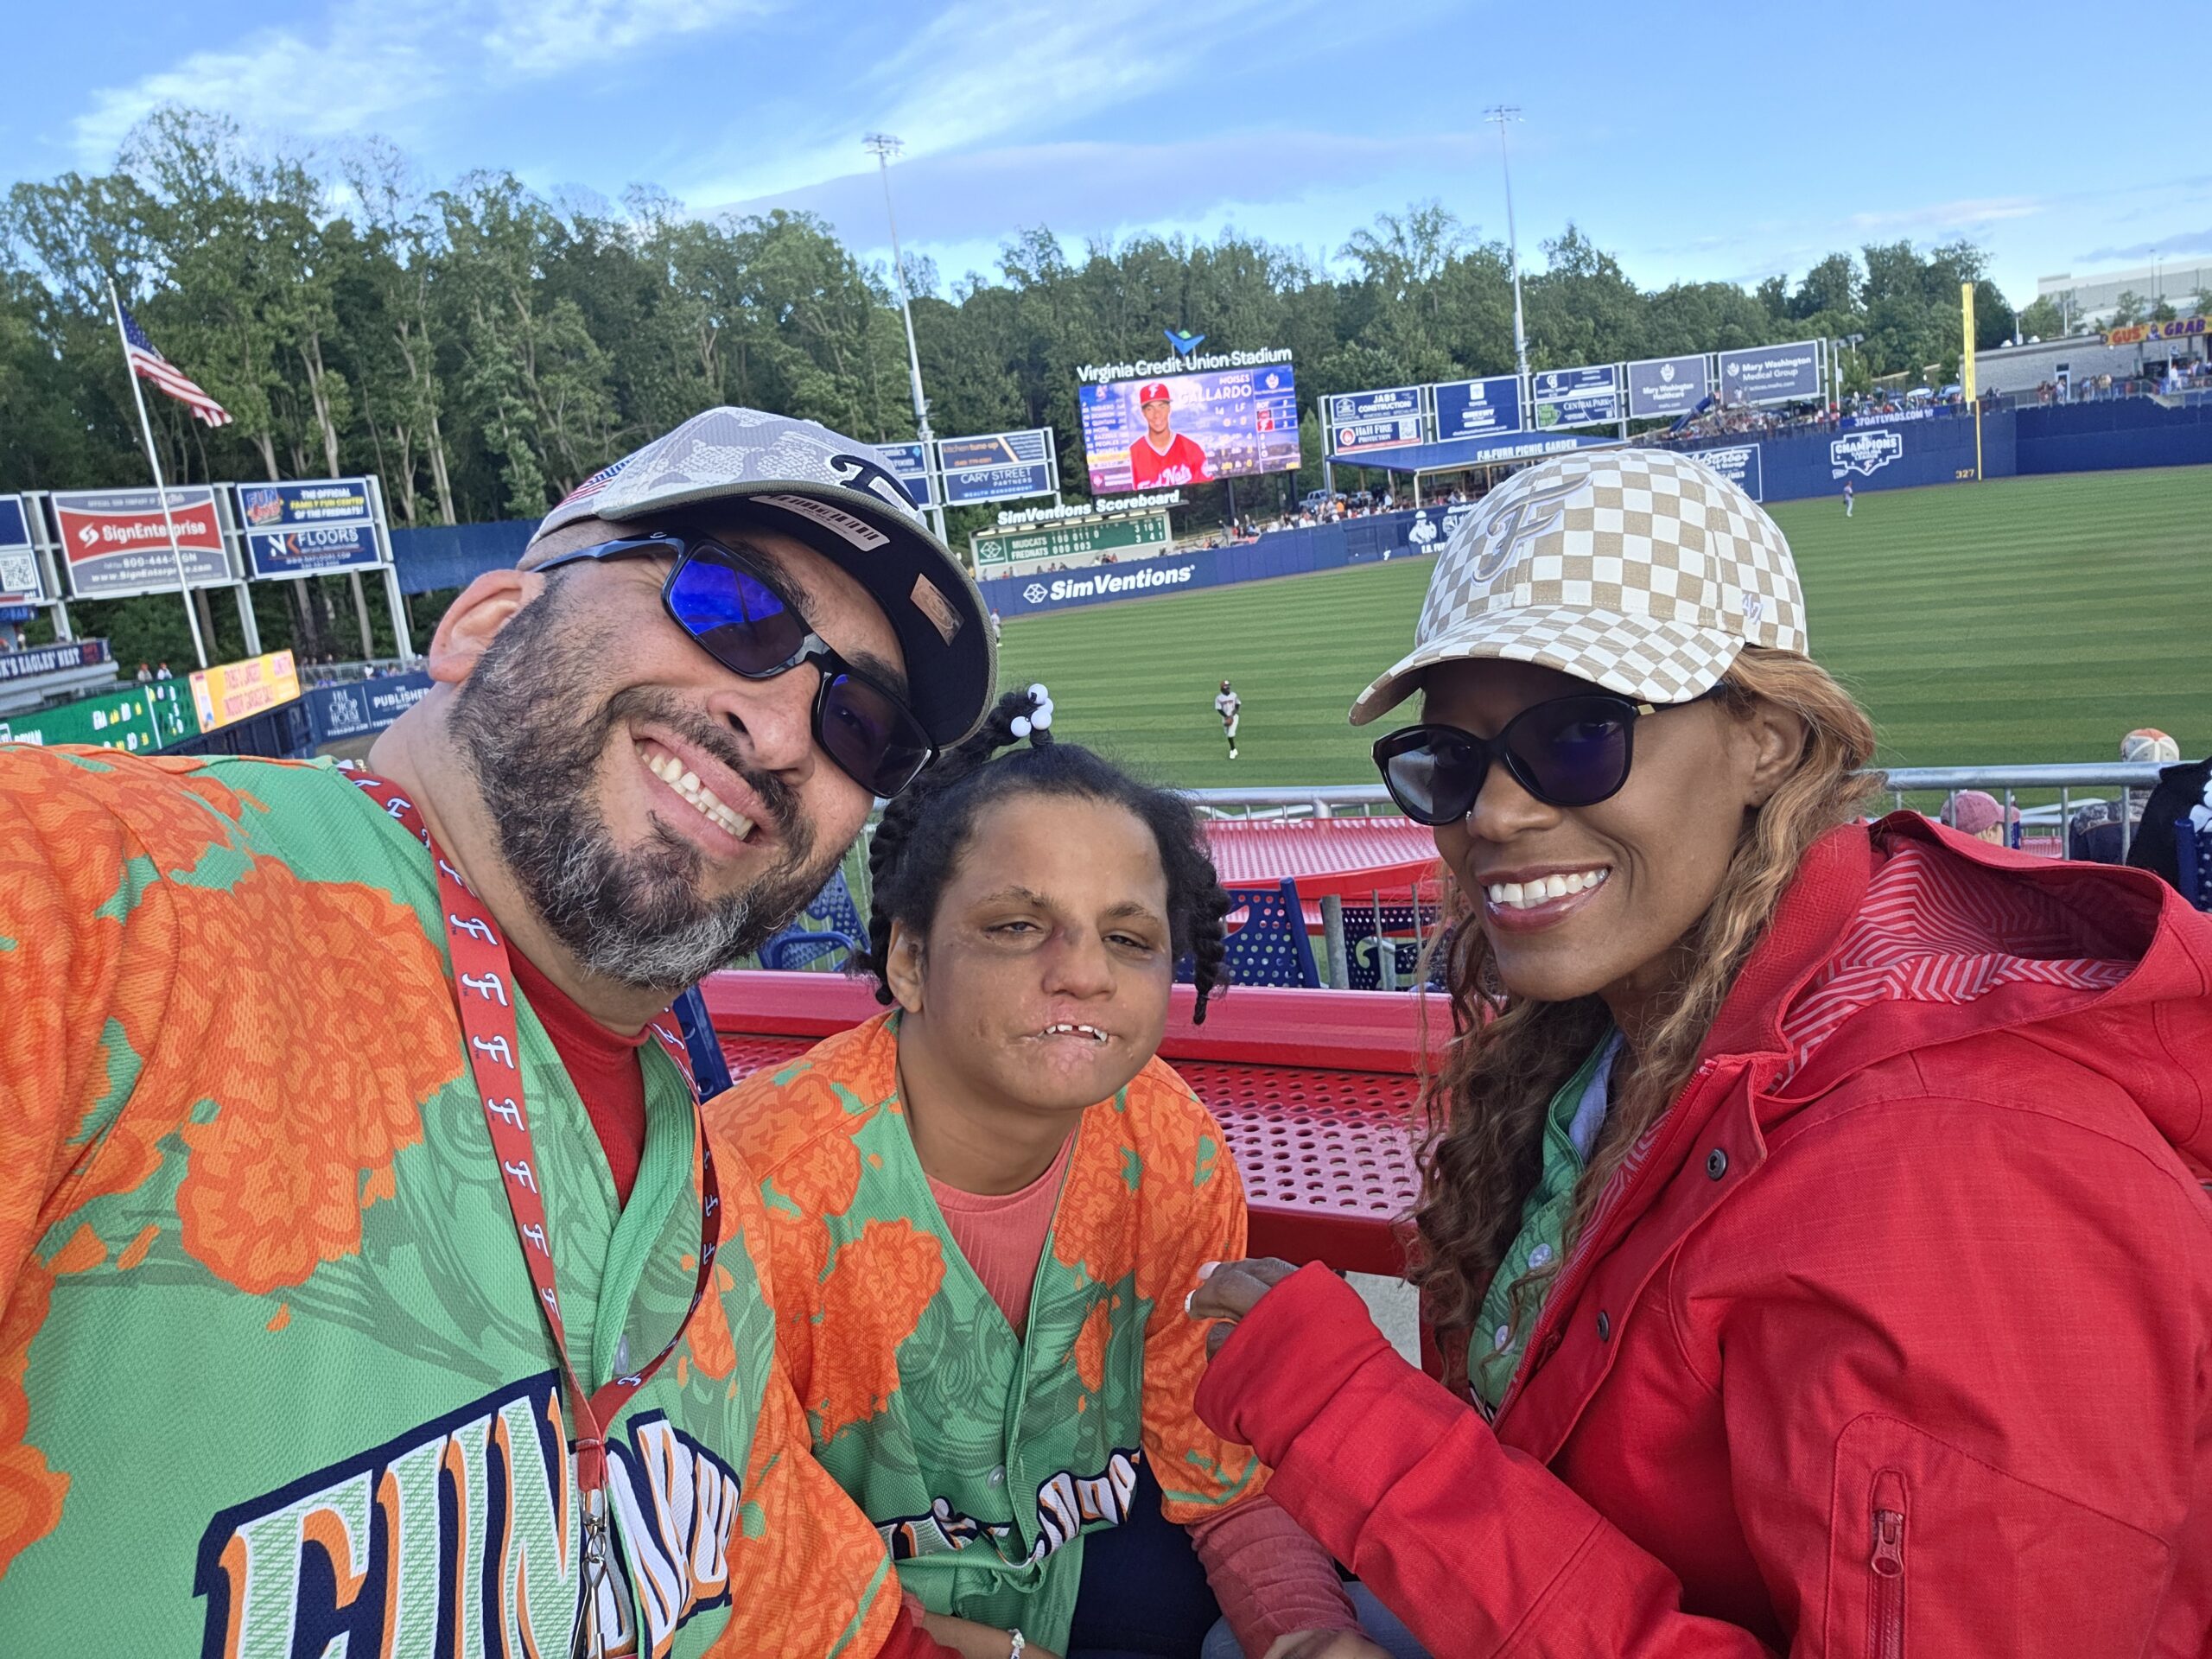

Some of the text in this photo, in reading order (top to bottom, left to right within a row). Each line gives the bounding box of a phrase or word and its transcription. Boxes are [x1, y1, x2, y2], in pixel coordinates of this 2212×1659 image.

[2164, 319, 2207, 336] GRAB
[1077, 346, 1293, 383] Virginia Credit Union Stadium
[1742, 356, 1811, 373] Mary Washington
[1219, 373, 1250, 385] MOISES
[1743, 367, 1798, 382] Medical Group
[1179, 384, 1252, 404] GALLARDO
[1563, 397, 1610, 410] CENTRAL PARK
[1375, 423, 1393, 435] FIRE
[1516, 442, 1543, 456] PICNIC
[1545, 438, 1577, 453] GARDEN
[1835, 438, 1897, 454] CHAMPIONS
[960, 467, 1033, 485] CARY STREET
[993, 477, 1033, 487] PARTNERS
[246, 486, 279, 509] FUN
[997, 490, 1180, 525] SimVentions Scoreboard
[297, 527, 359, 546] FLOORS
[1012, 537, 1047, 550] MUDCATS
[1012, 545, 1049, 560] FREDNATS
[1050, 566, 1192, 601] SimVentions
[57, 647, 80, 668] NEST
[461, 972, 510, 1008] F
[473, 1035, 516, 1071] F
[487, 1098, 525, 1133] F
[505, 1160, 538, 1195] F
[522, 1223, 550, 1259] F
